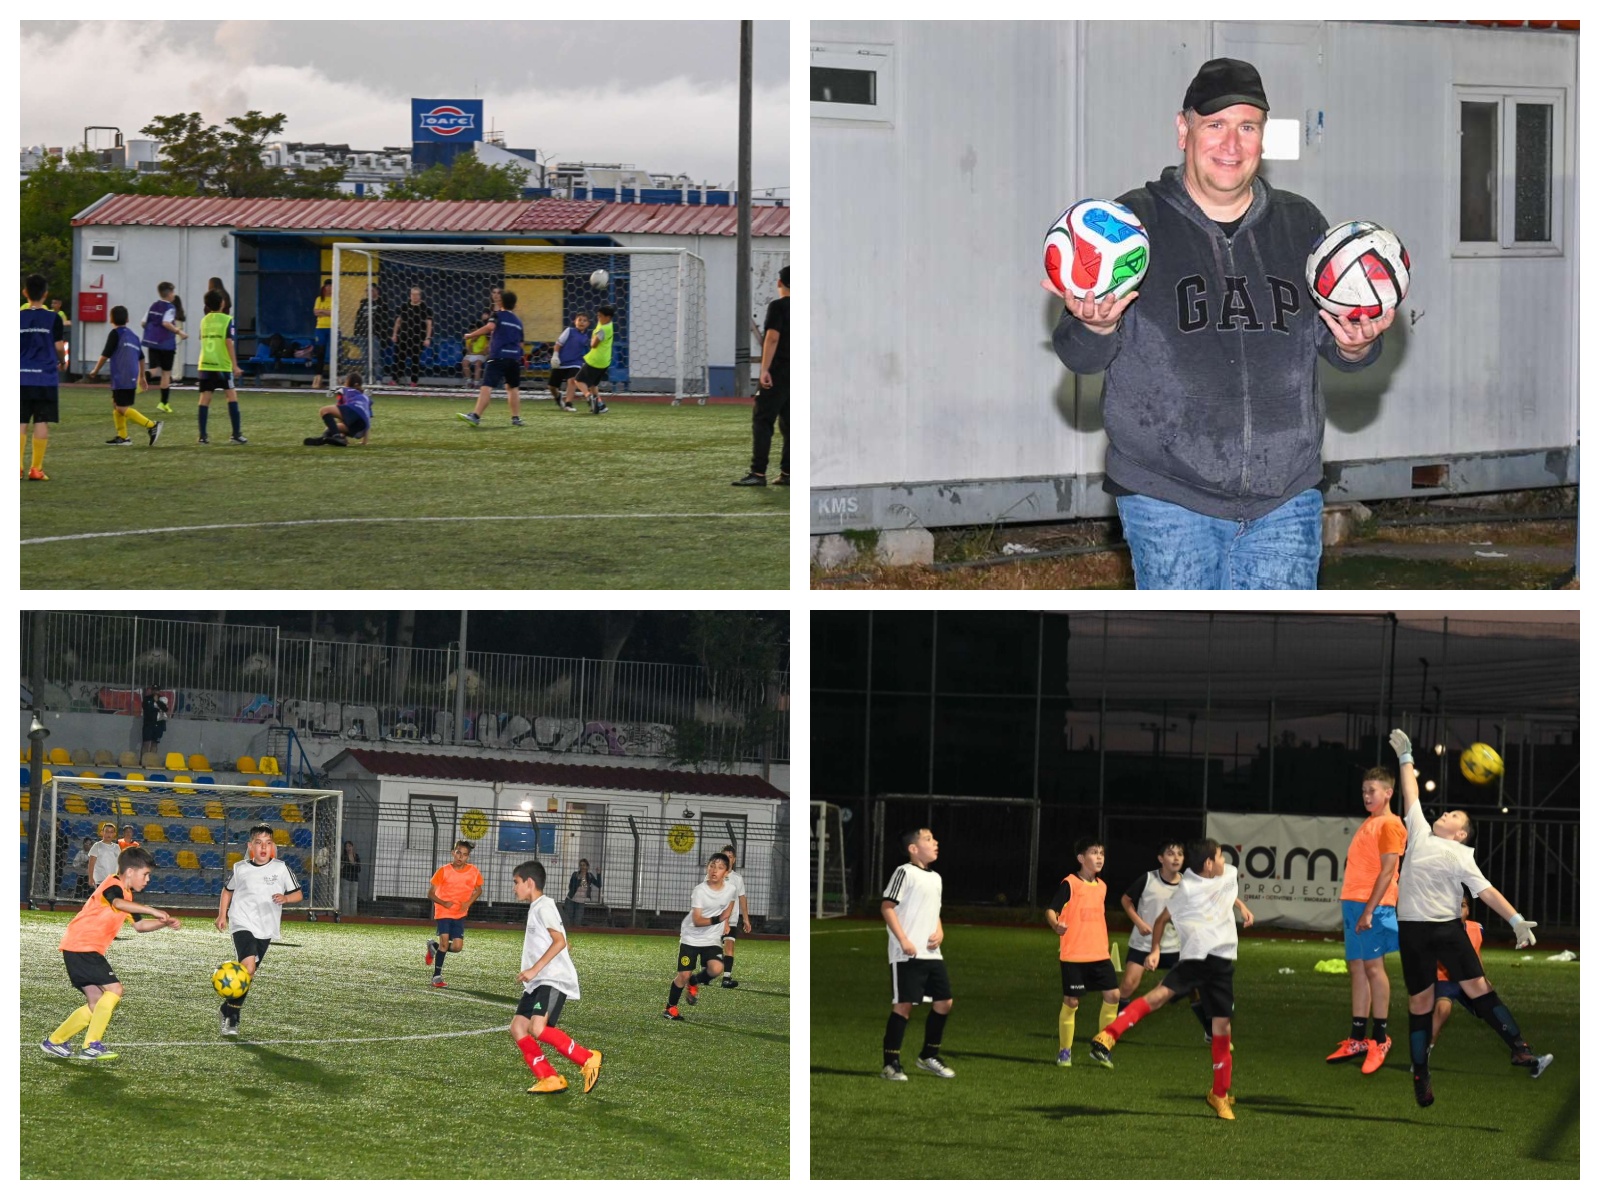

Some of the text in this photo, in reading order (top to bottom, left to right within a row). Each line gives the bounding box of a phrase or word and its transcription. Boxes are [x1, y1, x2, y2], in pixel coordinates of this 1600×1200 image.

[1175, 274, 1301, 336] GAP
[818, 496, 858, 514] KMS
[1244, 883, 1338, 897] PROJECT
